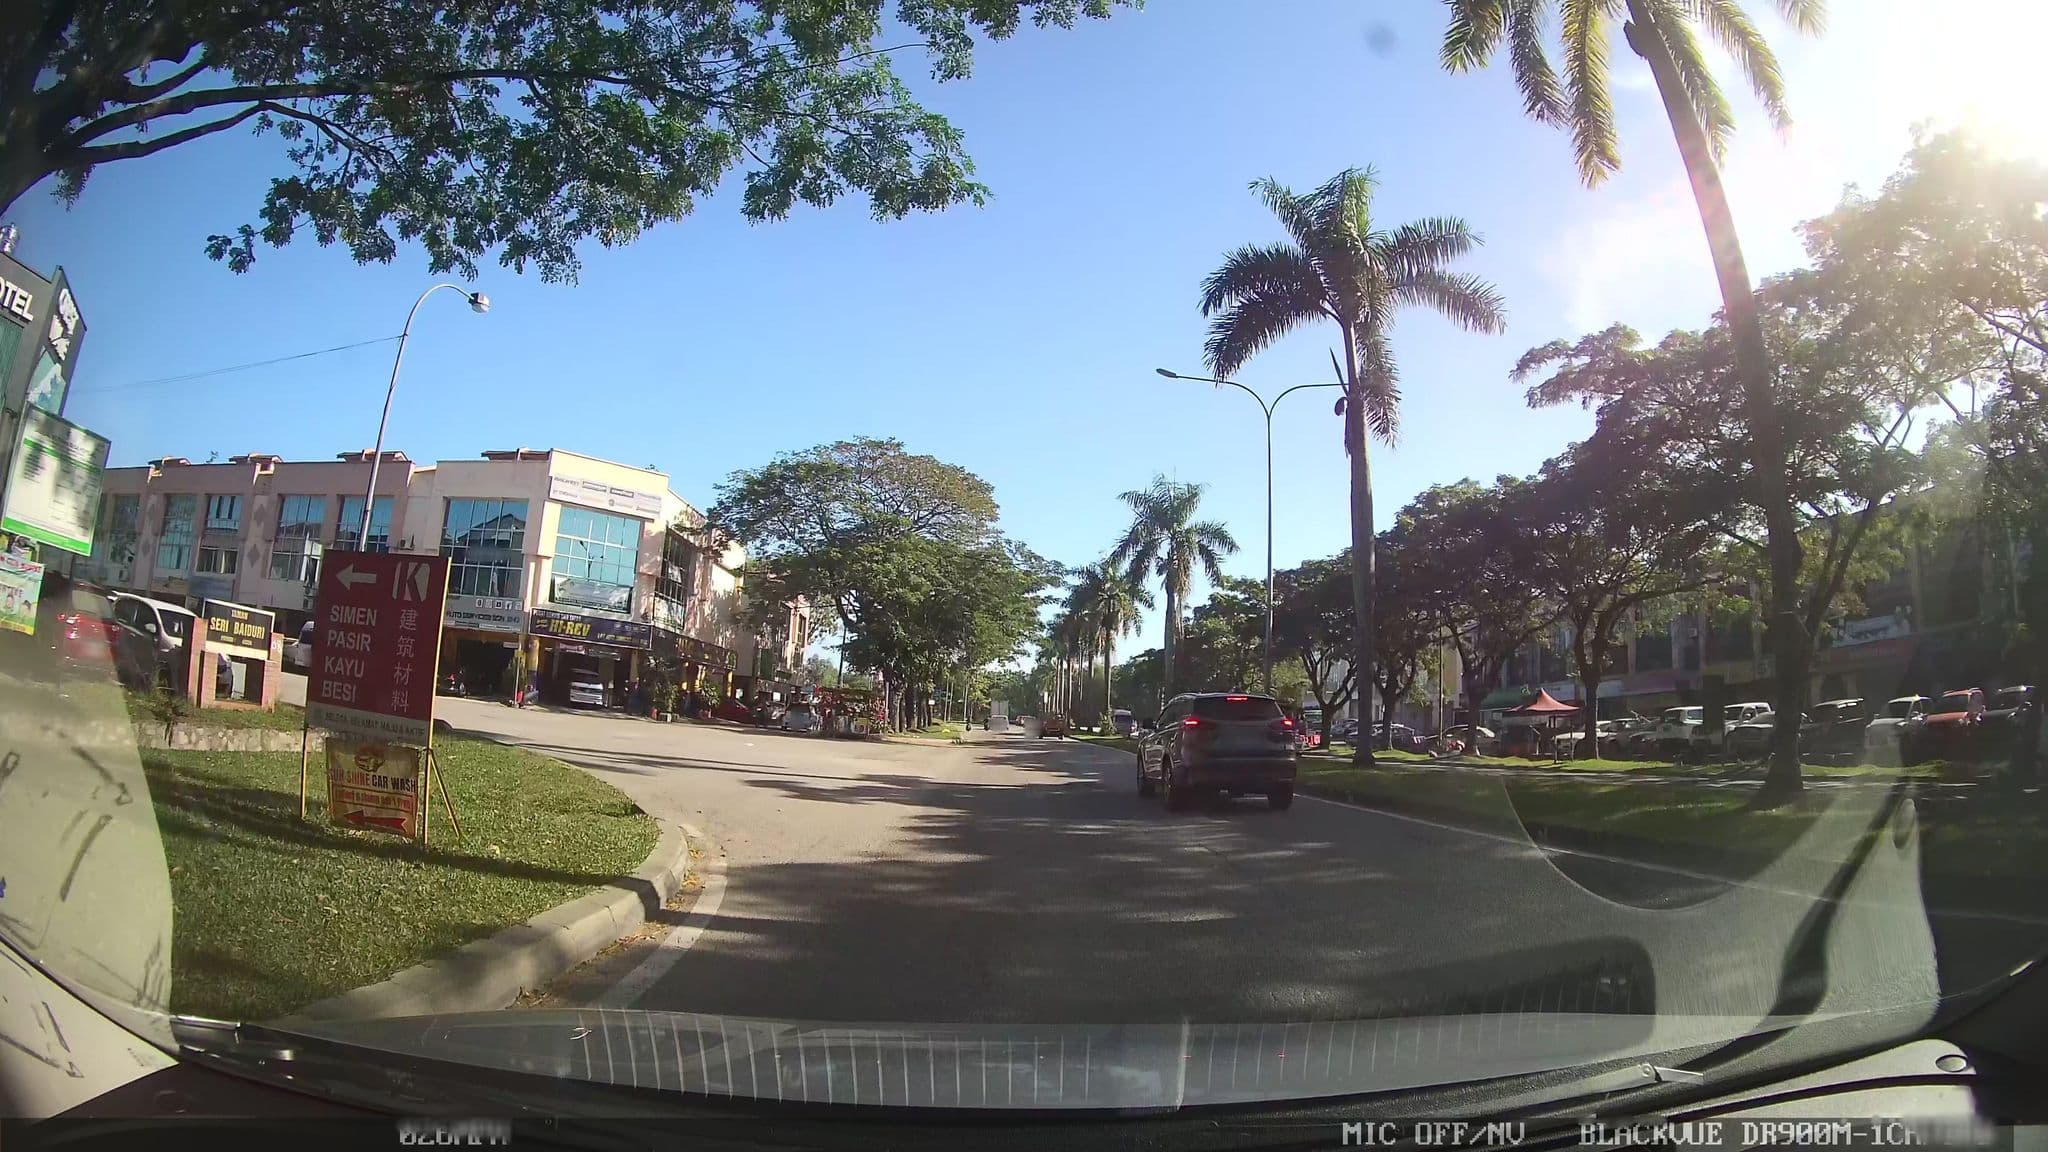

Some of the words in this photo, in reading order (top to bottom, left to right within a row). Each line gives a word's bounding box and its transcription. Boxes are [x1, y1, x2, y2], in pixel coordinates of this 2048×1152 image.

[330, 605, 377, 627] SIMEN
[210, 617, 229, 633] SERI
[233, 622, 265, 639] BAIDURI
[549, 619, 592, 637] HI-REV
[327, 630, 371, 652] PASIR
[324, 655, 365, 678] KAYU
[391, 608, 419, 713] 建筑材料
[322, 680, 357, 703] BESI
[372, 774, 389, 790] CAR
[391, 776, 416, 793] WASH
